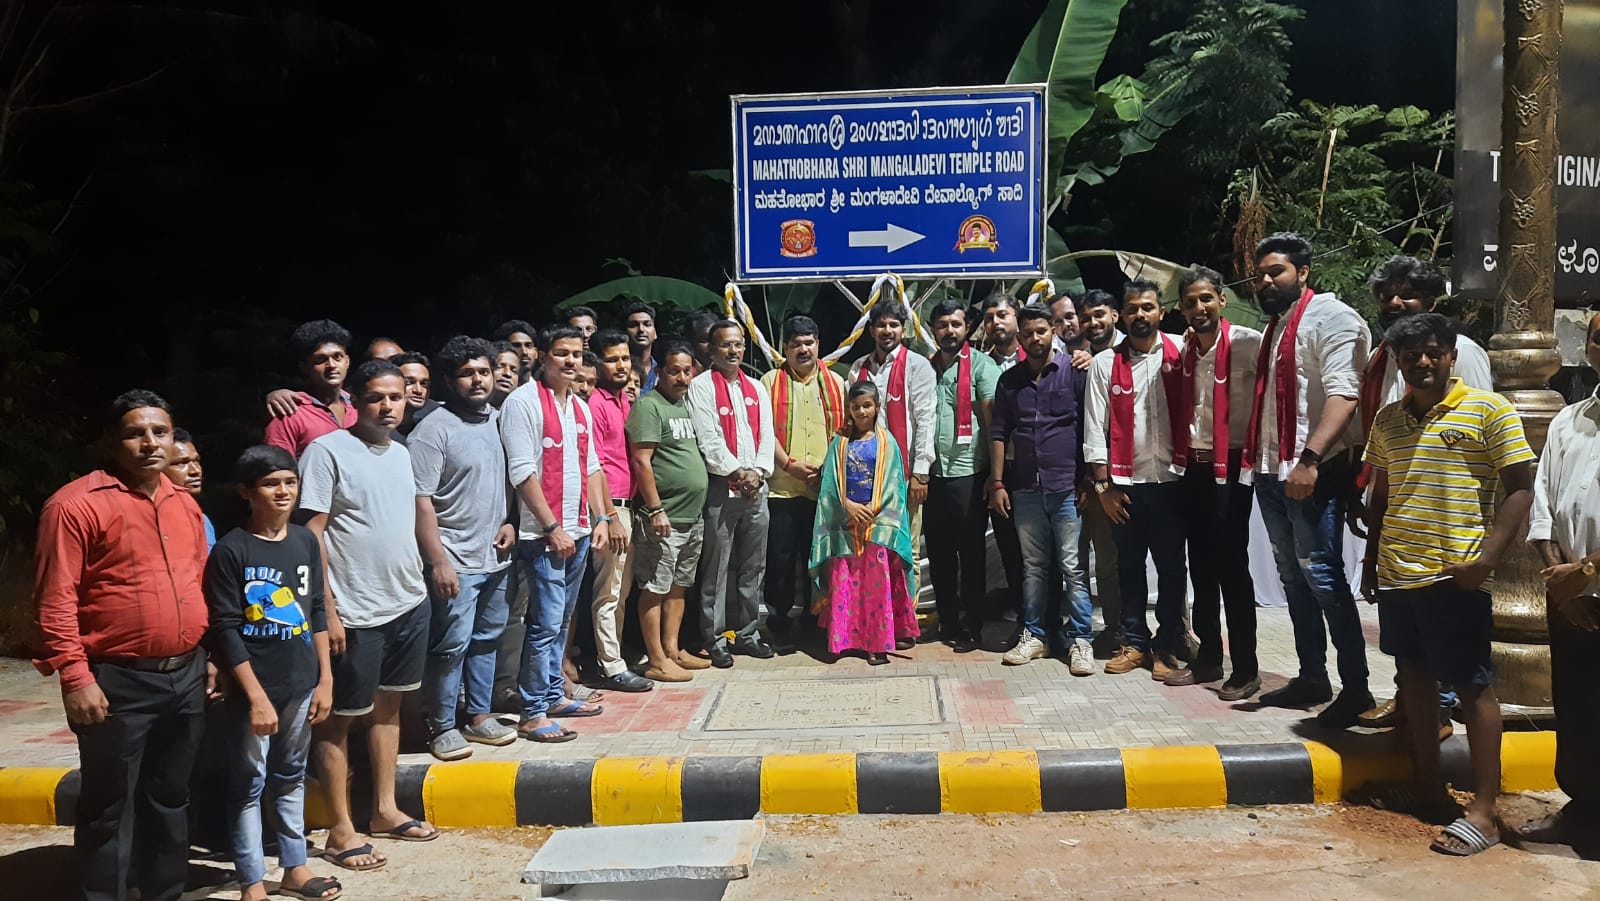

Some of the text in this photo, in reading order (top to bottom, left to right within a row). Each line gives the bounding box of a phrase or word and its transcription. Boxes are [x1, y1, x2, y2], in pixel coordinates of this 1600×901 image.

[753, 150, 1024, 181] MAHATHOBHARA SHRI MANGALADEVI TEMPLE ROAD
[830, 188, 846, 213] ಶ್ರೀ
[850, 185, 920, 207] ಮಂಗಳಾದೇವಿ
[997, 183, 1024, 202] ಸಾದಿ
[244, 566, 282, 585] ROLL
[297, 565, 309, 596] 3
[242, 623, 294, 640] WITH IT
